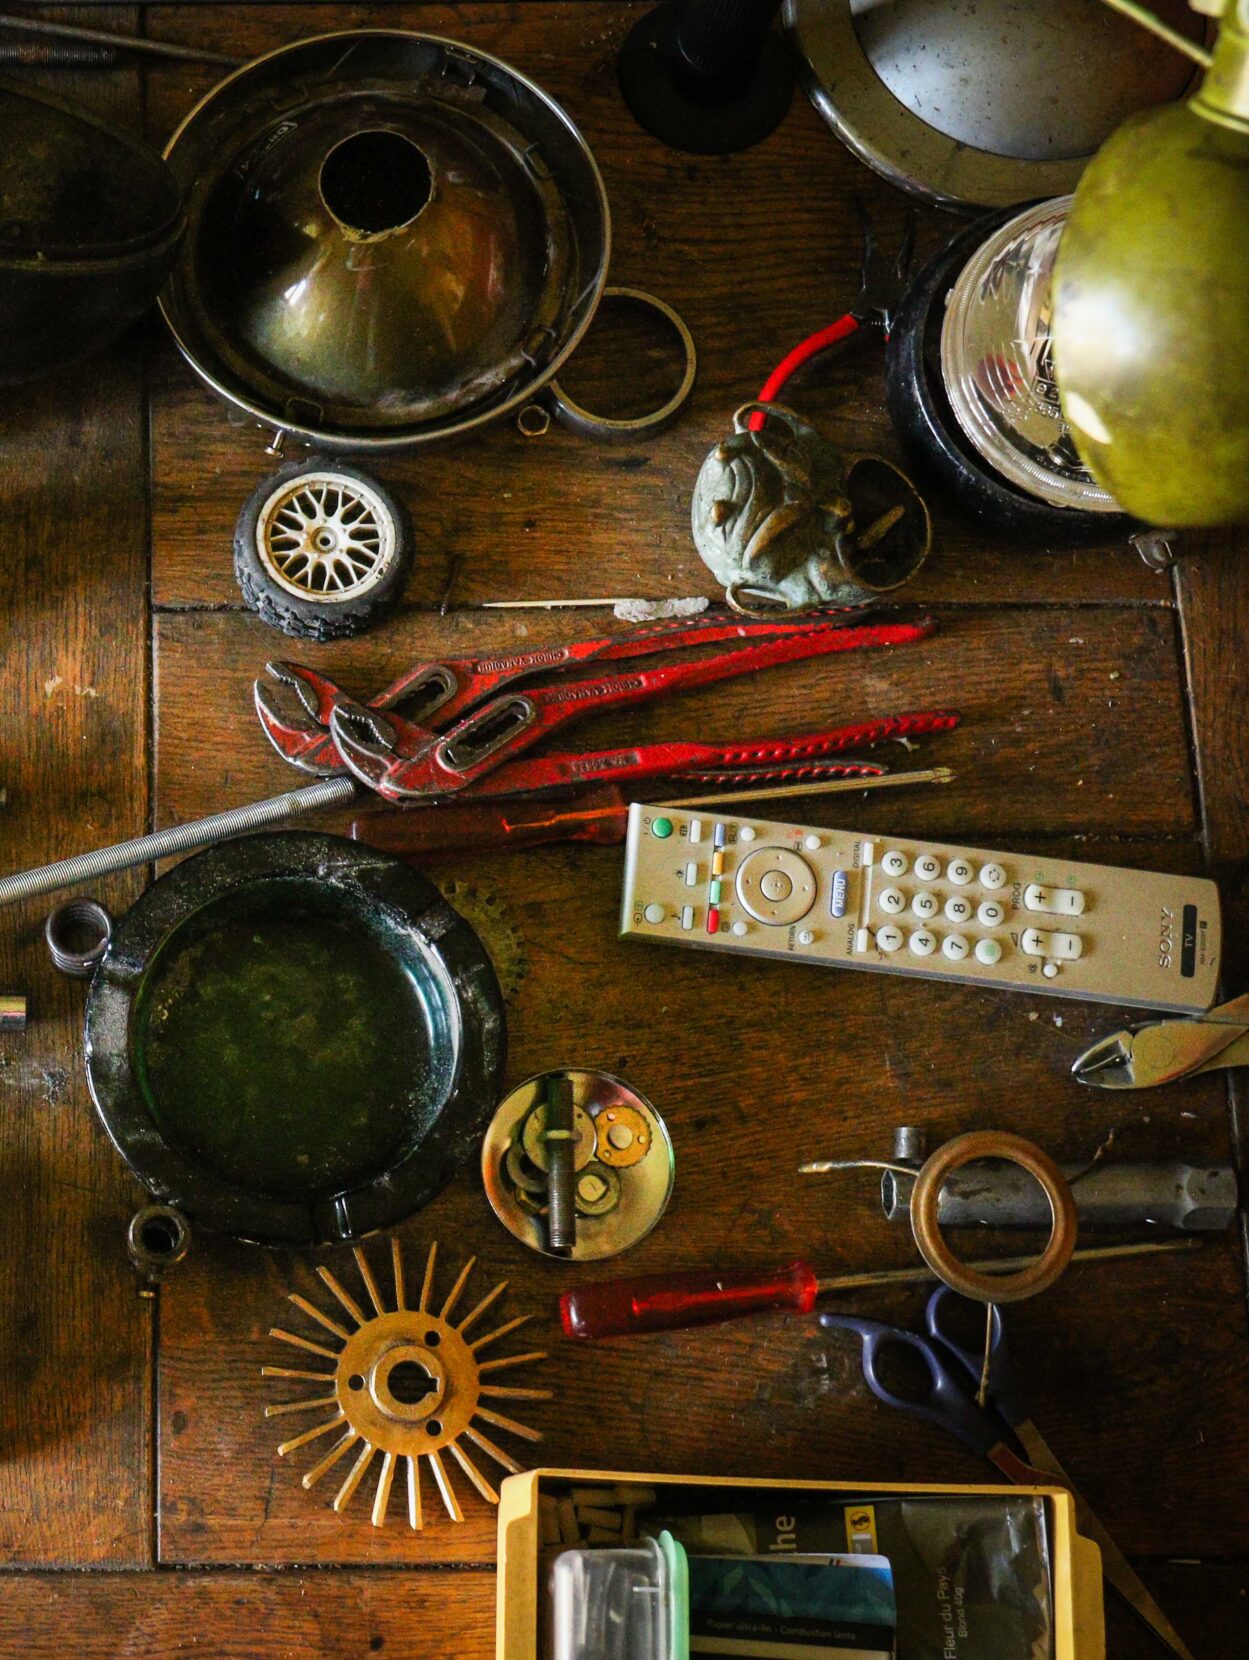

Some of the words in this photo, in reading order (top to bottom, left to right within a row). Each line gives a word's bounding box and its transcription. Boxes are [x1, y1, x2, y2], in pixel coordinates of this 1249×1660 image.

[853, 840, 862, 868] DIGITAL
[890, 856, 903, 868] 3
[923, 861, 935, 872] 6
[955, 866, 968, 876] 9
[834, 878, 847, 909] MENU
[887, 895, 900, 905] 2
[1012, 882, 1022, 910] PROG
[920, 899, 933, 909] 5
[953, 903, 966, 913] 8
[985, 907, 998, 918] 0
[787, 924, 797, 952] RETURN
[846, 923, 855, 956] ANALOG
[918, 937, 931, 947] 4
[951, 941, 964, 950] 7
[1159, 905, 1174, 969] SONY
[1185, 933, 1193, 948] TV
[769, 1515, 797, 1553] he
[936, 1567, 952, 1600] Pays
[953, 1586, 965, 1606] 40g
[939, 1604, 952, 1622] du
[955, 1608, 968, 1638] Blond
[943, 1624, 957, 1660] Fleur
